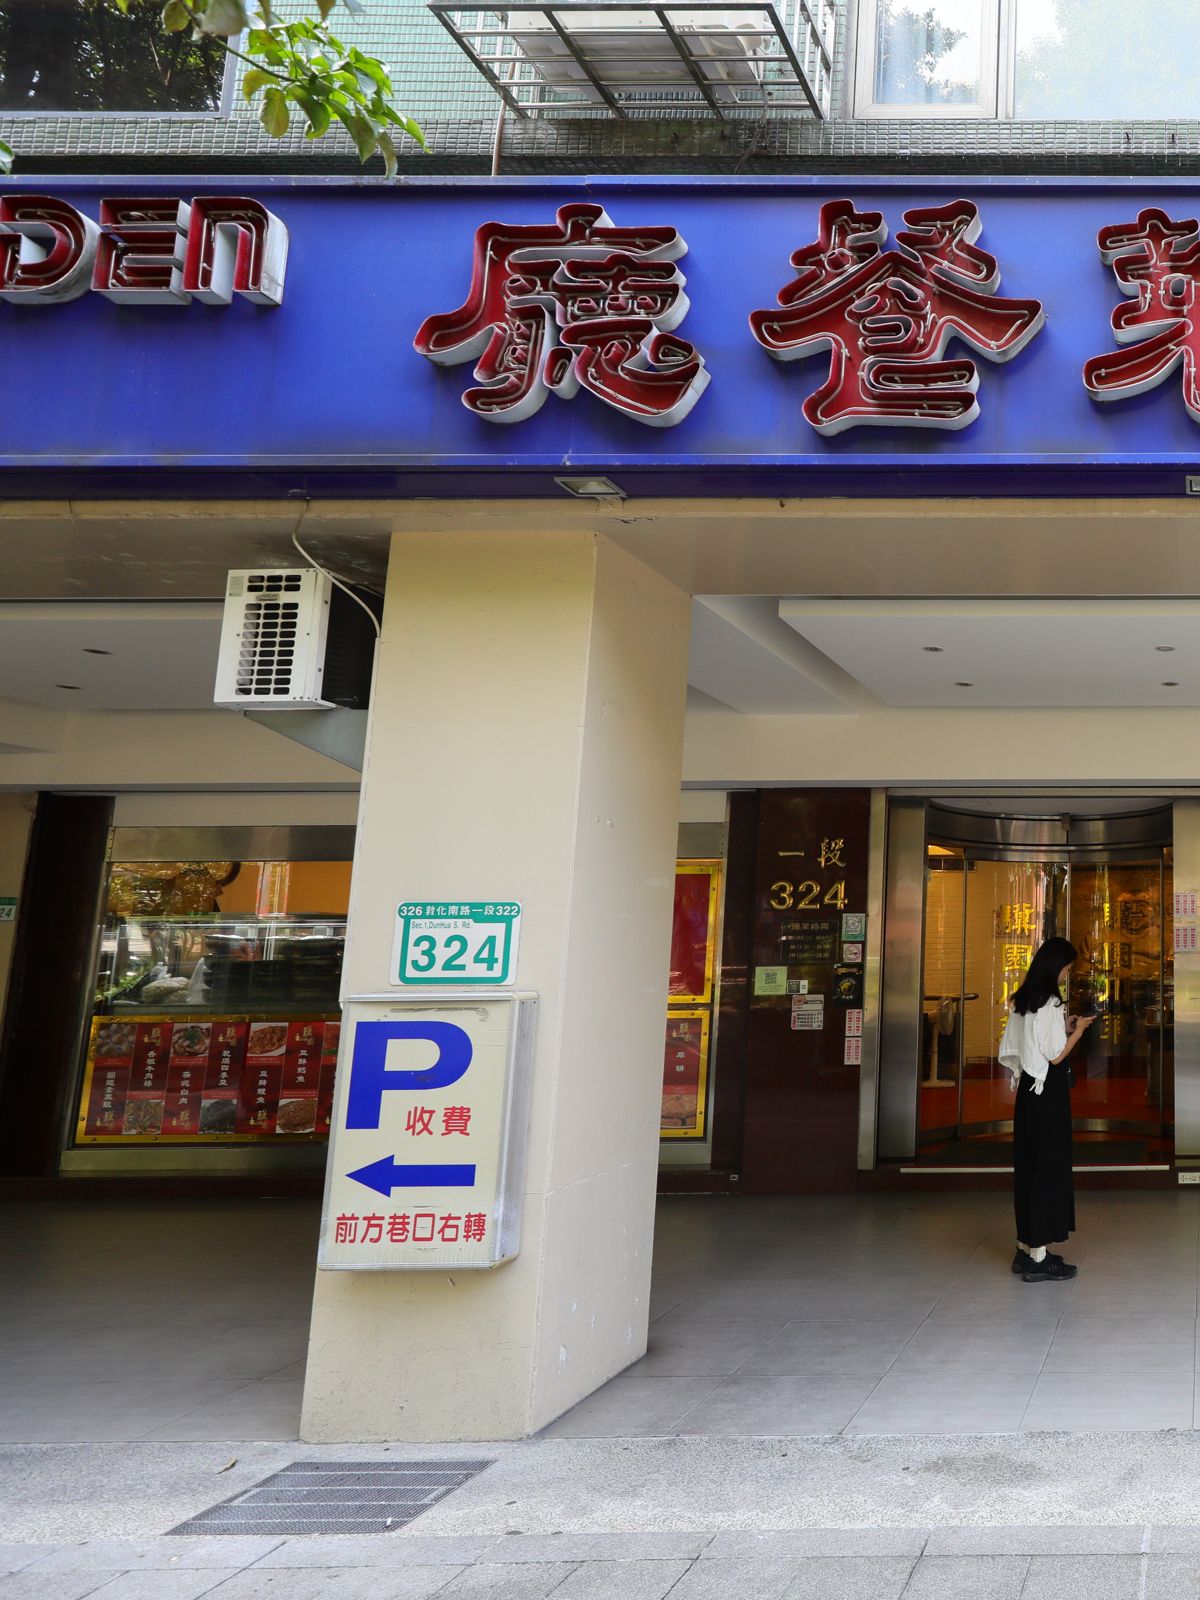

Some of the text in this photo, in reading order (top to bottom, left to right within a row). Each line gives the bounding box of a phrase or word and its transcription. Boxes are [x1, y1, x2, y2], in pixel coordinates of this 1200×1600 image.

[777, 837, 847, 869] 一段
[769, 880, 848, 910] 324
[400, 905, 518, 916] 326 敦化南路一段 322
[453, 921, 459, 929] S.
[461, 921, 472, 929] Rd.
[411, 934, 499, 972] 324
[345, 1021, 473, 1129] P
[405, 1106, 472, 1136] 收費
[335, 1213, 487, 1244] 前方巷口右轉
